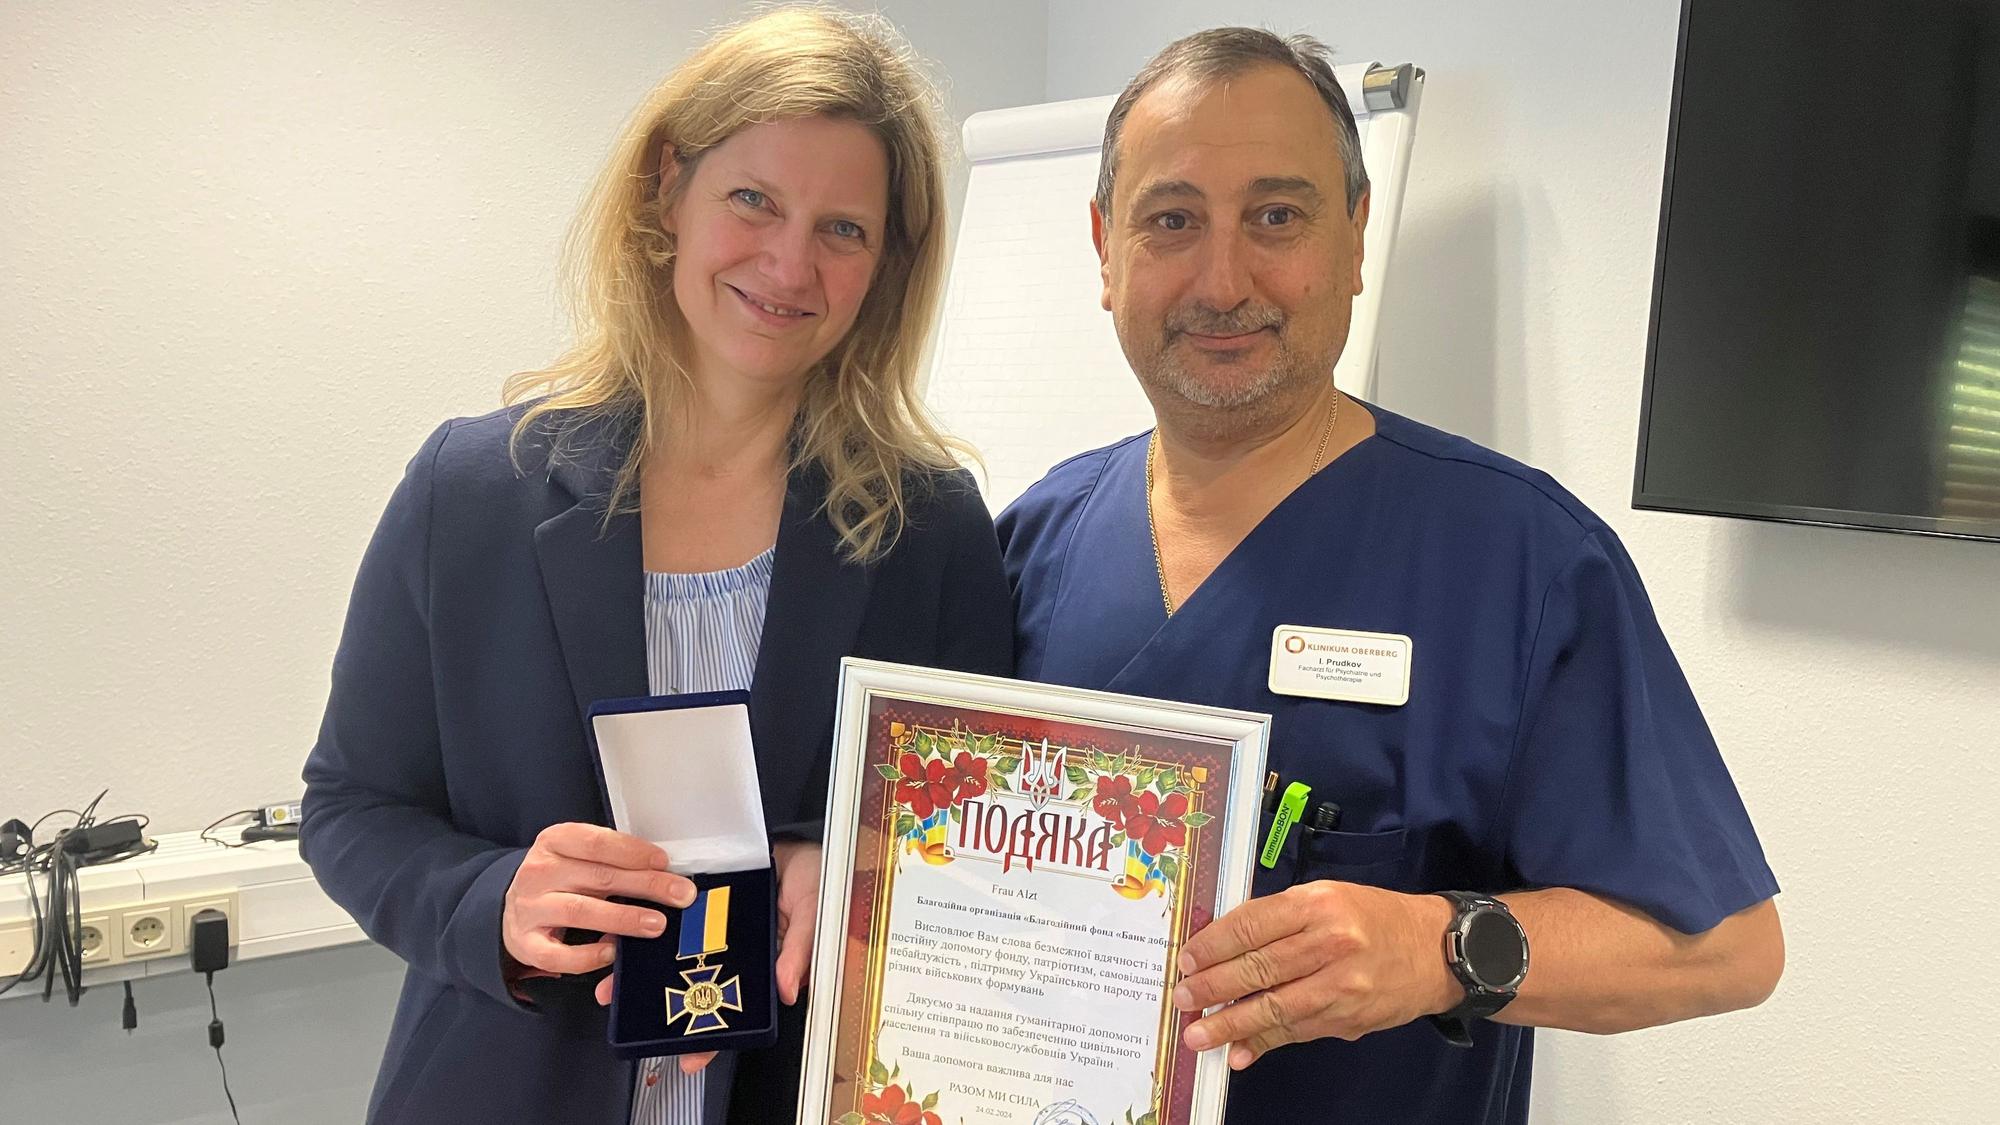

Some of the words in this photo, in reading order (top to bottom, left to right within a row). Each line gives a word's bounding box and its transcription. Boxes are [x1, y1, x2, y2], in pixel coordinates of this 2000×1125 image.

[1298, 665, 1325, 673] Facharzt
[1336, 668, 1368, 677] Psychiatrie
[1307, 644, 1349, 654] KLINIKUM
[1351, 648, 1398, 658] OBERBERG
[1326, 658, 1362, 668] Prudkov
[1316, 673, 1362, 683] Psychotherapie
[959, 800, 1114, 874] ПОДЯКА
[992, 884, 1014, 897] Frau
[1016, 889, 1038, 900] Alzt
[917, 896, 967, 912] Благодійна
[970, 905, 1021, 921] організація
[1024, 914, 1087, 932] «Благодійний
[1090, 925, 1113, 938] фонд
[1116, 930, 1146, 943] «Банк
[891, 932, 938, 949] постійну
[940, 940, 992, 958] допомогу
[995, 949, 1031, 966] фонду,
[1034, 957, 1096, 976] патріотизм,
[914, 920, 974, 938] Висловлює
[977, 930, 999, 944] Вам
[1002, 938, 1031, 949] слова
[1034, 941, 1092, 960] безмежної
[1094, 952, 1148, 970] вдячності
[1152, 963, 1162, 972] за
[888, 960, 922, 975] різних
[925, 967, 983, 985] військових
[985, 978, 1045, 997] формувань
[890, 946, 962, 968] небайдужість
[970, 960, 1026, 980] підтримку
[1030, 969, 1100, 991] Українського
[1104, 984, 1142, 1001] народу
[1145, 993, 1157, 1002] та
[884, 1003, 924, 1020] спільну
[926, 1012, 984, 1030] співпрацю
[986, 1022, 999, 1032] по
[1002, 1026, 1077, 1047] забезпеченню
[1080, 1040, 1141, 1059] цивільного
[906, 992, 953, 1009] Дякуємо
[955, 1004, 966, 1012] за
[969, 1005, 1013, 1020] надання
[1015, 1014, 1086, 1034] гуманітарної
[1088, 1027, 1142, 1045] допомоги
[883, 1020, 936, 1036] населення
[939, 1029, 950, 1038] та
[953, 1031, 1066, 1060] військовослужбовців
[1070, 1051, 1114, 1069] України
[902, 1046, 930, 1060] Ваша
[932, 1054, 983, 1070] допомога
[986, 1063, 1031, 1080] важлива
[1033, 1072, 1052, 1084] для
[1055, 1077, 1074, 1088] нас
[949, 1082, 985, 1098] РАЗОМ
[988, 1090, 1006, 1102] МИ
[1009, 1094, 1040, 1108] СИЛА
[976, 1106, 1013, 1118] 24.02.2024
